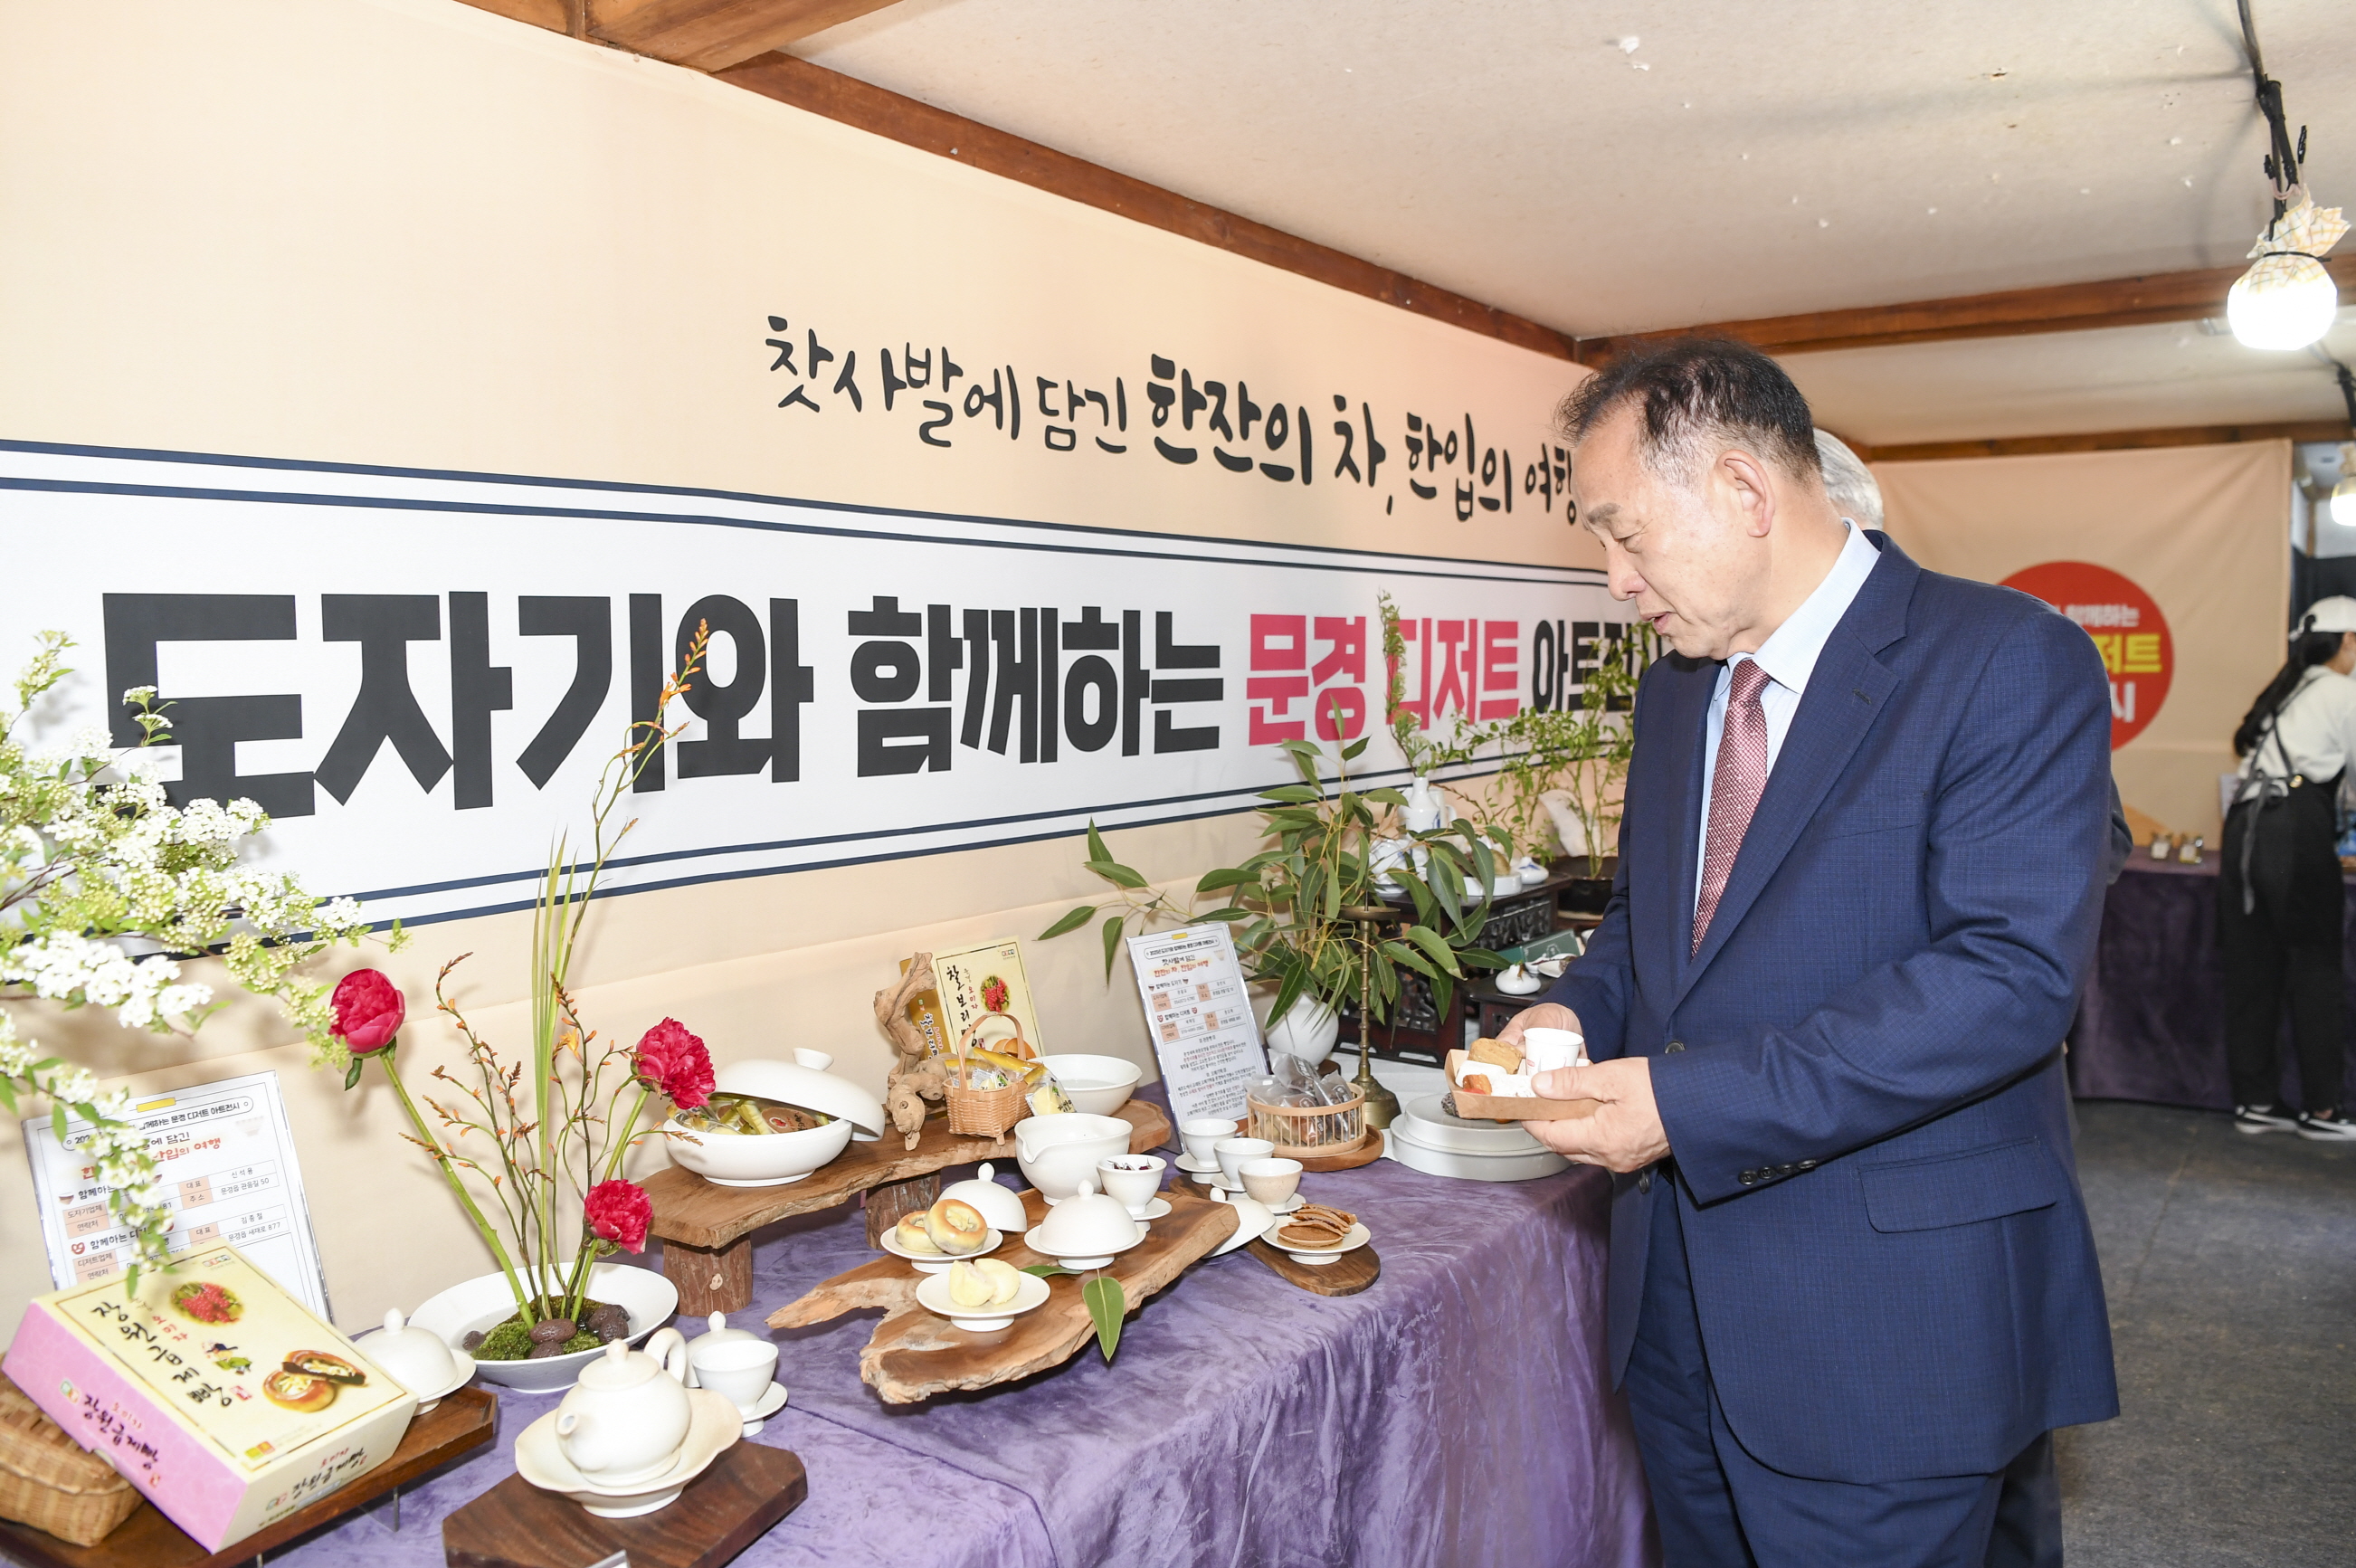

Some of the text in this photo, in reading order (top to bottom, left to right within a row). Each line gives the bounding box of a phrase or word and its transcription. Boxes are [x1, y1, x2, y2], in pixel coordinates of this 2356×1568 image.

[765, 315, 1021, 447] 찻사발에
[1036, 375, 1127, 453] 담긴
[1147, 353, 1312, 486] 한잔의
[1406, 412, 1512, 522] 한입의
[2091, 634, 2162, 674] 저트
[95, 591, 814, 819] 도자기와
[848, 595, 1224, 778] 함께하는
[1246, 613, 1366, 746] 문경
[1385, 618, 1519, 730] 디저트
[170, 1114, 186, 1124] 문경
[186, 1108, 210, 1119] 디저트
[210, 1102, 240, 1115] 아트전시
[166, 1131, 191, 1145] 담긴
[194, 1137, 222, 1150] 여행
[67, 1203, 102, 1219] 도자기업체
[76, 1220, 99, 1232] 연락처
[260, 1177, 270, 1185] 50
[87, 1269, 109, 1280] 연락처
[268, 1221, 280, 1230] 877
[90, 1232, 128, 1250] 함께하는
[77, 1252, 113, 1269] 디저트업체
